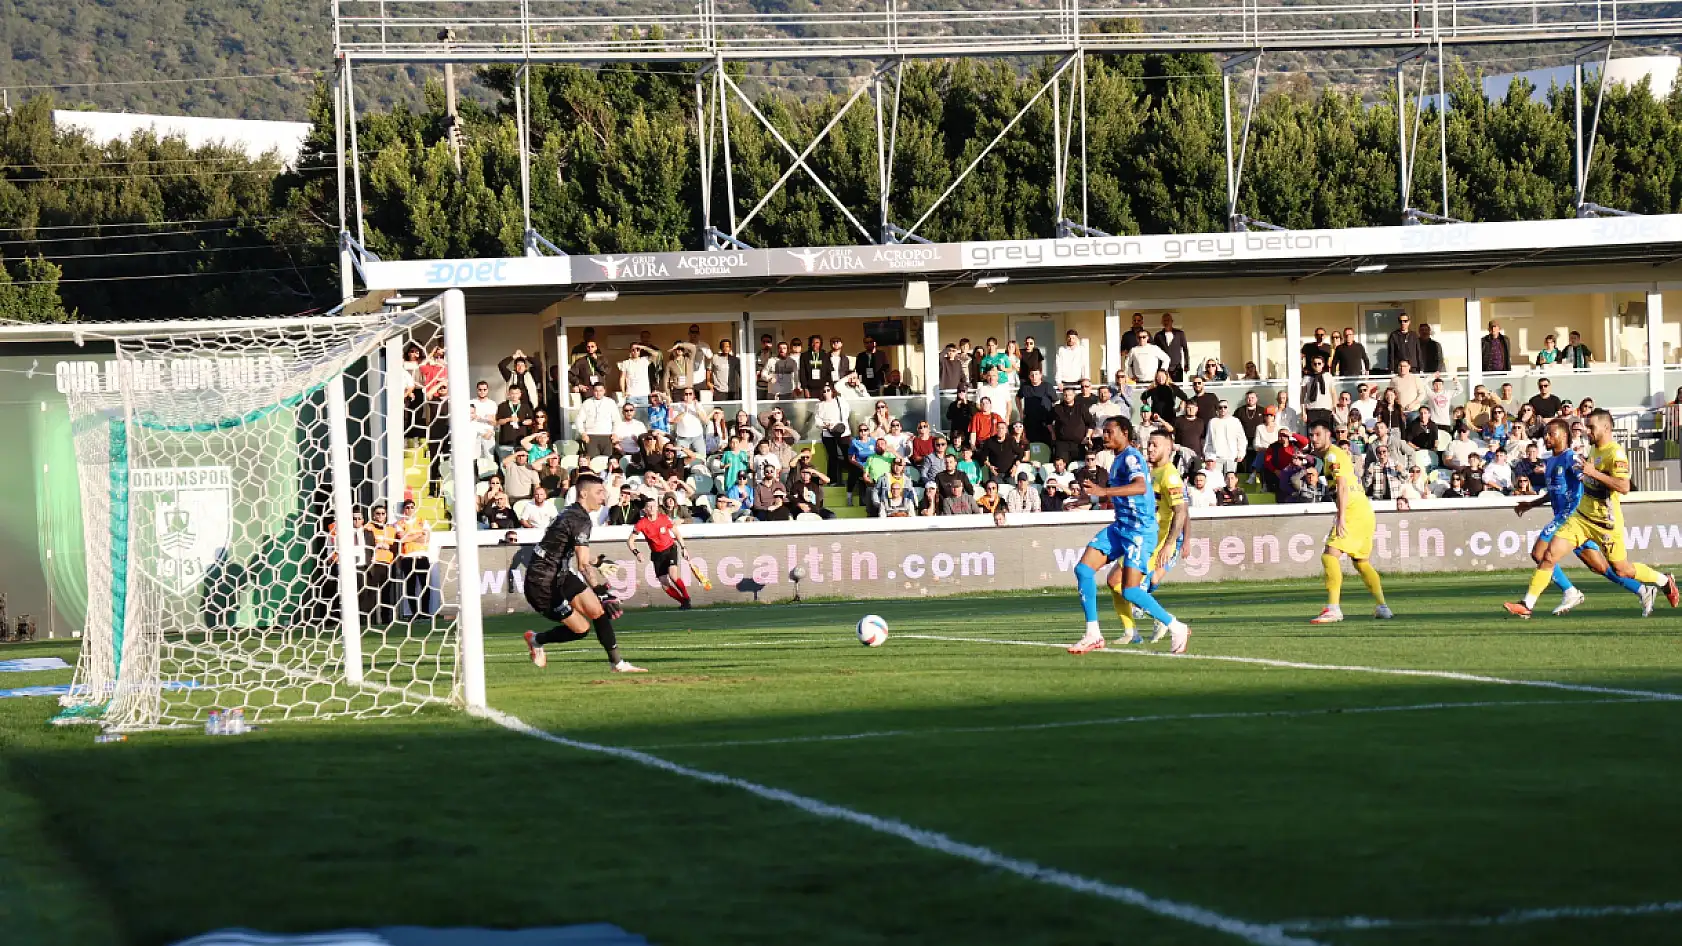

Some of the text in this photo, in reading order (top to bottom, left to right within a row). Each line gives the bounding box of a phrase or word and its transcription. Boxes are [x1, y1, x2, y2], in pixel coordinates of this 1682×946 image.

[971, 239, 1141, 266] grey beton
[1164, 232, 1333, 259] grey beton
[631, 255, 656, 264] GRUP
[677, 253, 748, 269] ACROPOL
[873, 247, 941, 262] ACROPOL
[620, 263, 670, 278] AURA
[818, 256, 866, 270] AURA
[425, 259, 507, 286] opet
[55, 360, 100, 394] OUR
[171, 358, 214, 390] OUR
